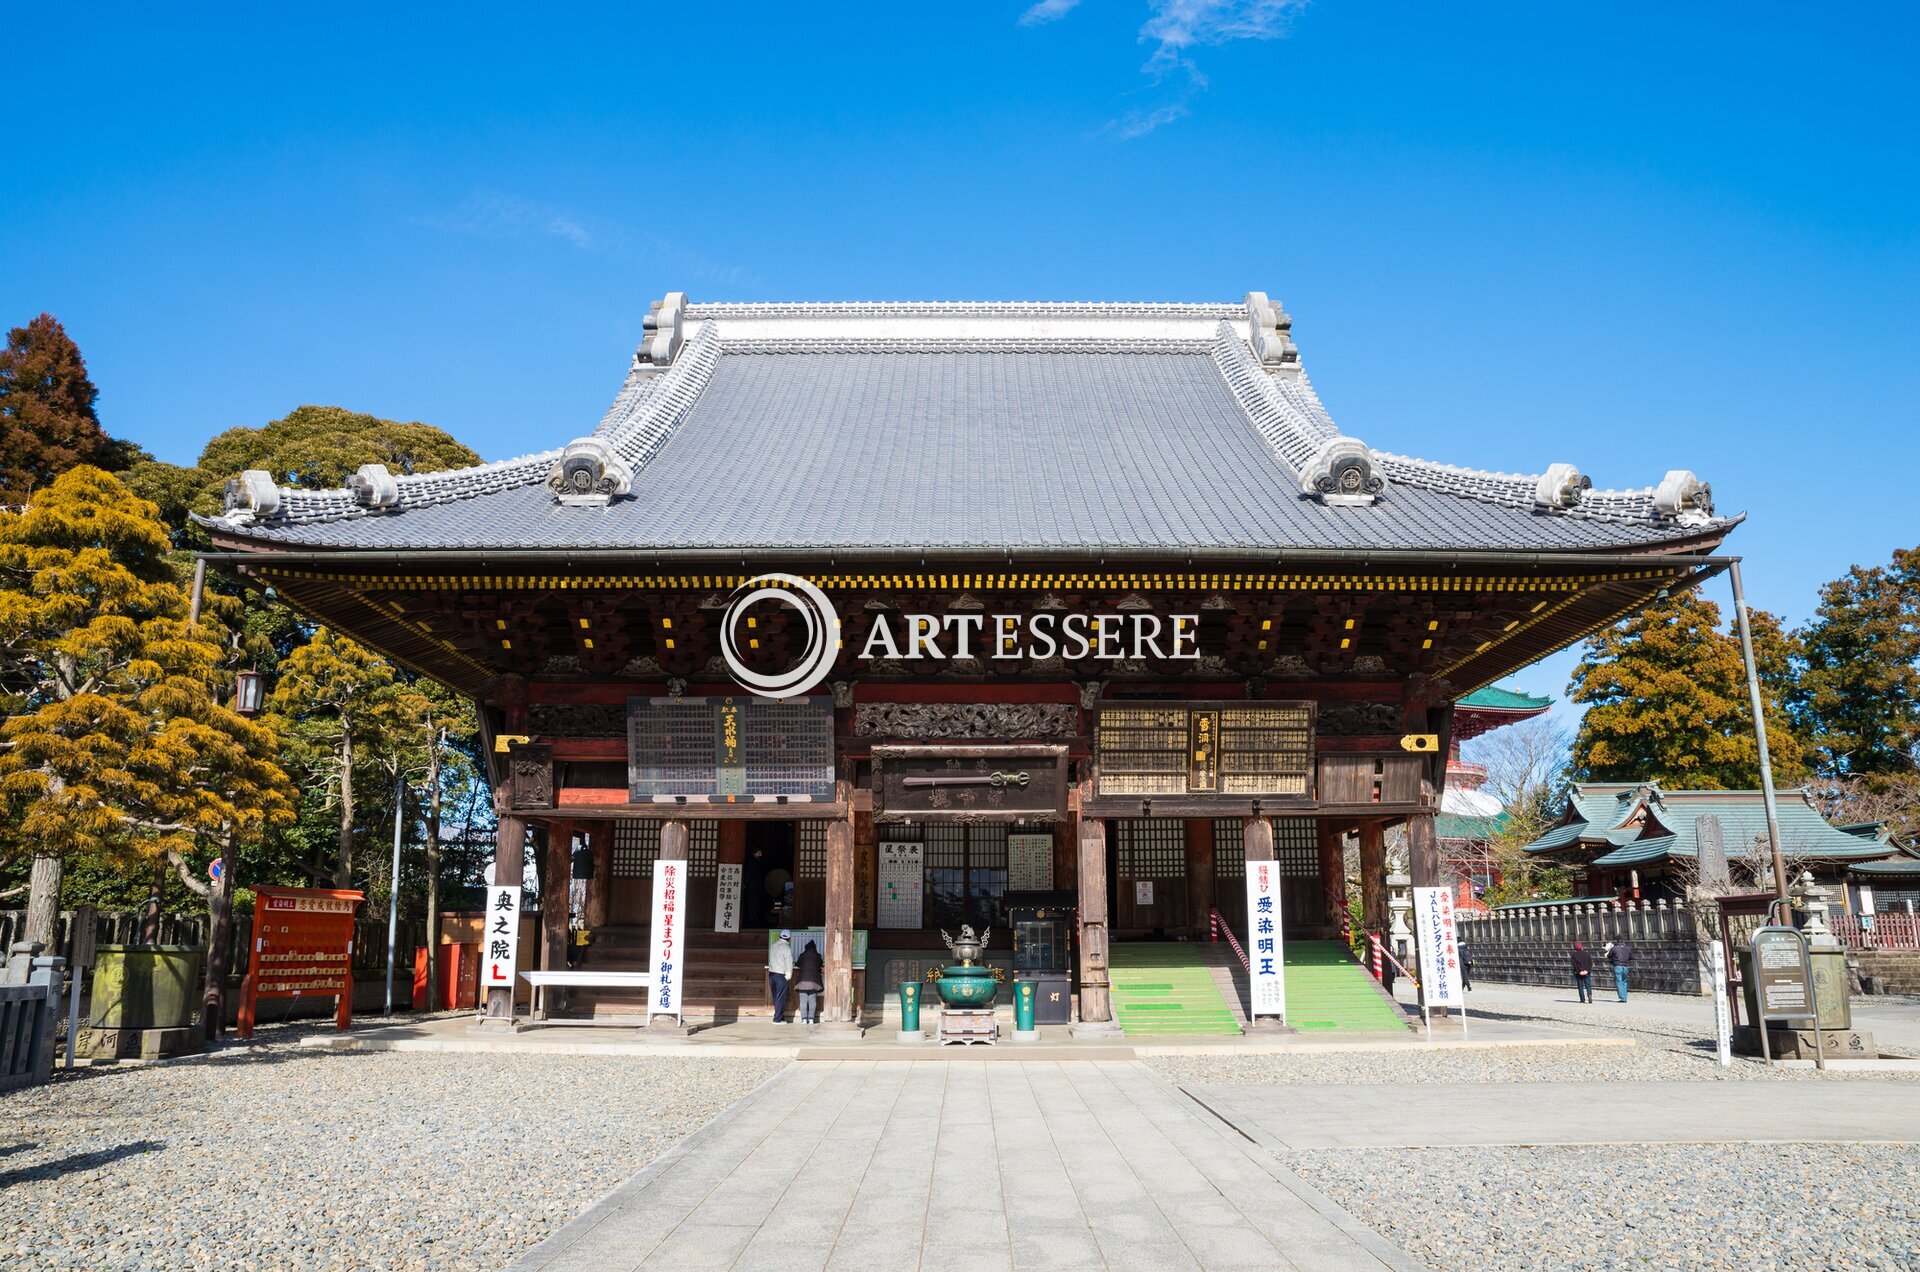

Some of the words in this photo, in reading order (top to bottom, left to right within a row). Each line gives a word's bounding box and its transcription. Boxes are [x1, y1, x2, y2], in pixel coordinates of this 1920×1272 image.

[490, 890, 514, 960] 奥之院
[723, 901, 733, 929] お守札
[1257, 896, 1277, 976] 愛染明王
